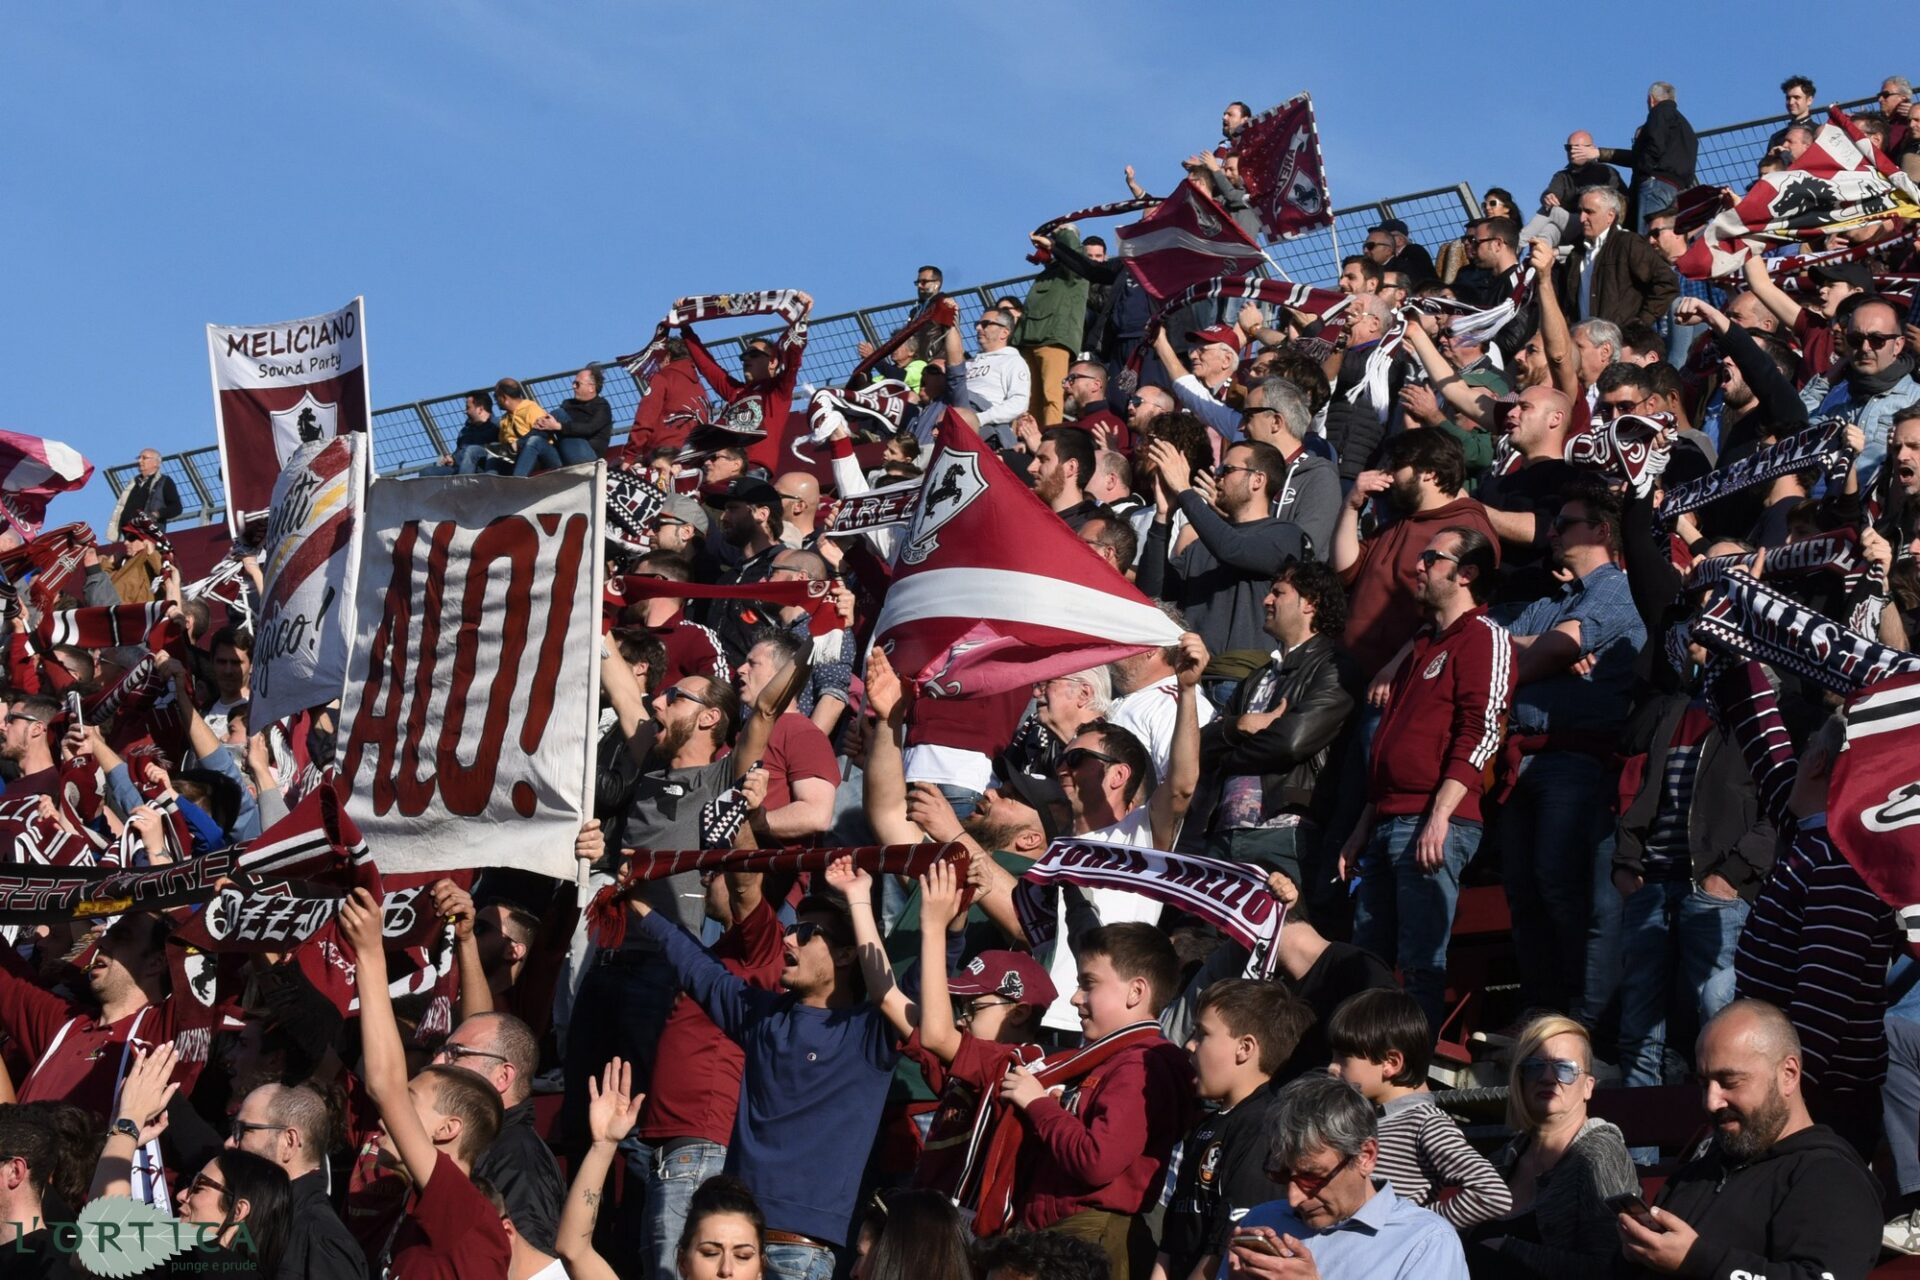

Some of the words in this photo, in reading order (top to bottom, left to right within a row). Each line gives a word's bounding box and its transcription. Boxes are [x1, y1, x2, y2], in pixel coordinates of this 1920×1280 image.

[227, 312, 355, 358] MELICIANO
[259, 362, 304, 378] Sound
[310, 352, 341, 371] Party
[1038, 843, 1149, 875] FORZA
[1155, 856, 1275, 926] AREZZO
